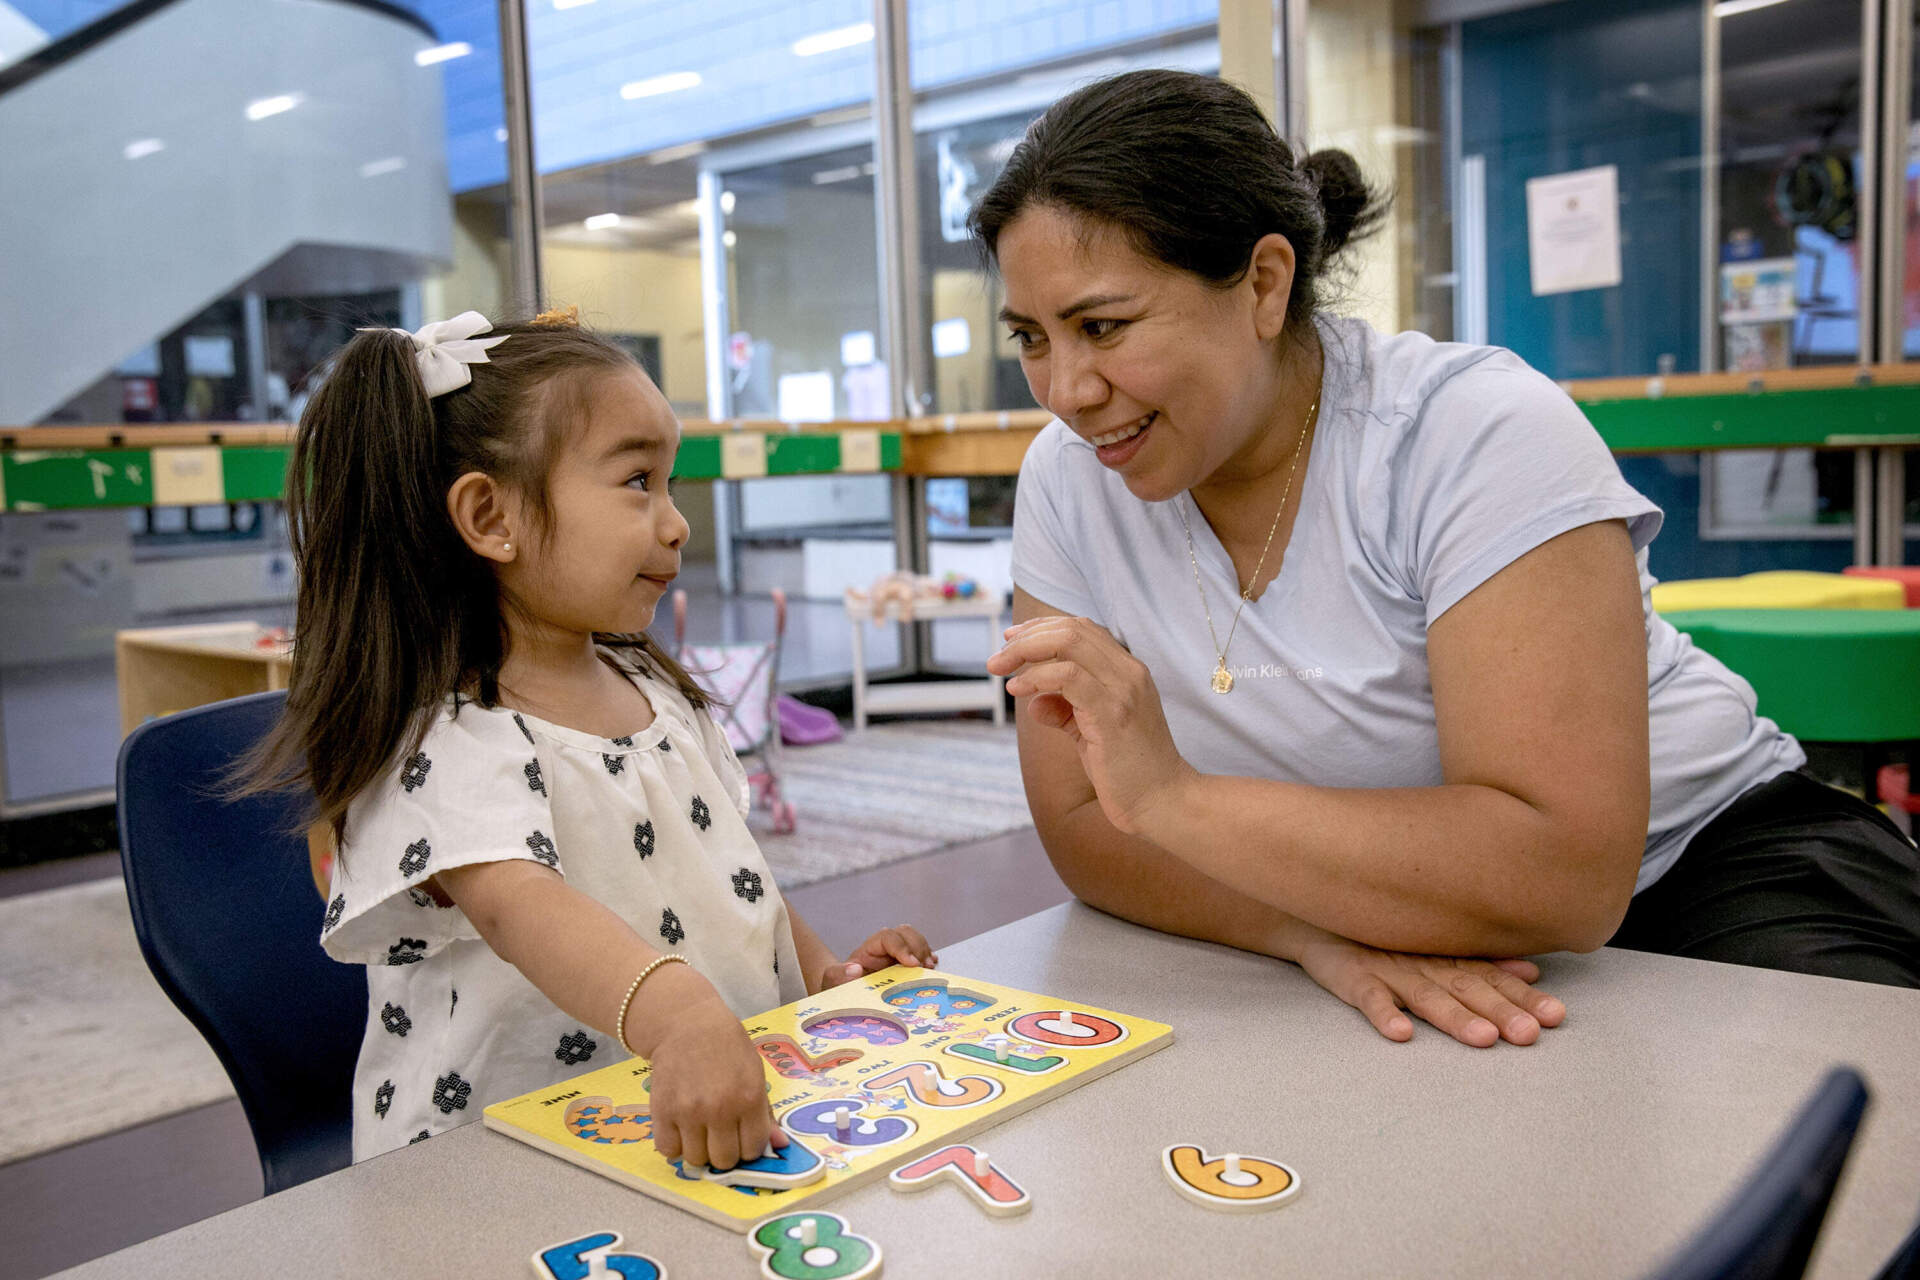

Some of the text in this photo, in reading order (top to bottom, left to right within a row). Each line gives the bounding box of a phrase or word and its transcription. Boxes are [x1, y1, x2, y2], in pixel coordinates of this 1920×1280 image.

[864, 978, 896, 992] FIVE
[794, 1007, 821, 1017] SIX
[984, 1006, 1021, 1022] ZERO
[920, 1035, 951, 1049] ONE
[857, 1060, 893, 1074] TWO
[541, 1090, 582, 1107] NINE
[772, 1091, 813, 1109] THRE
